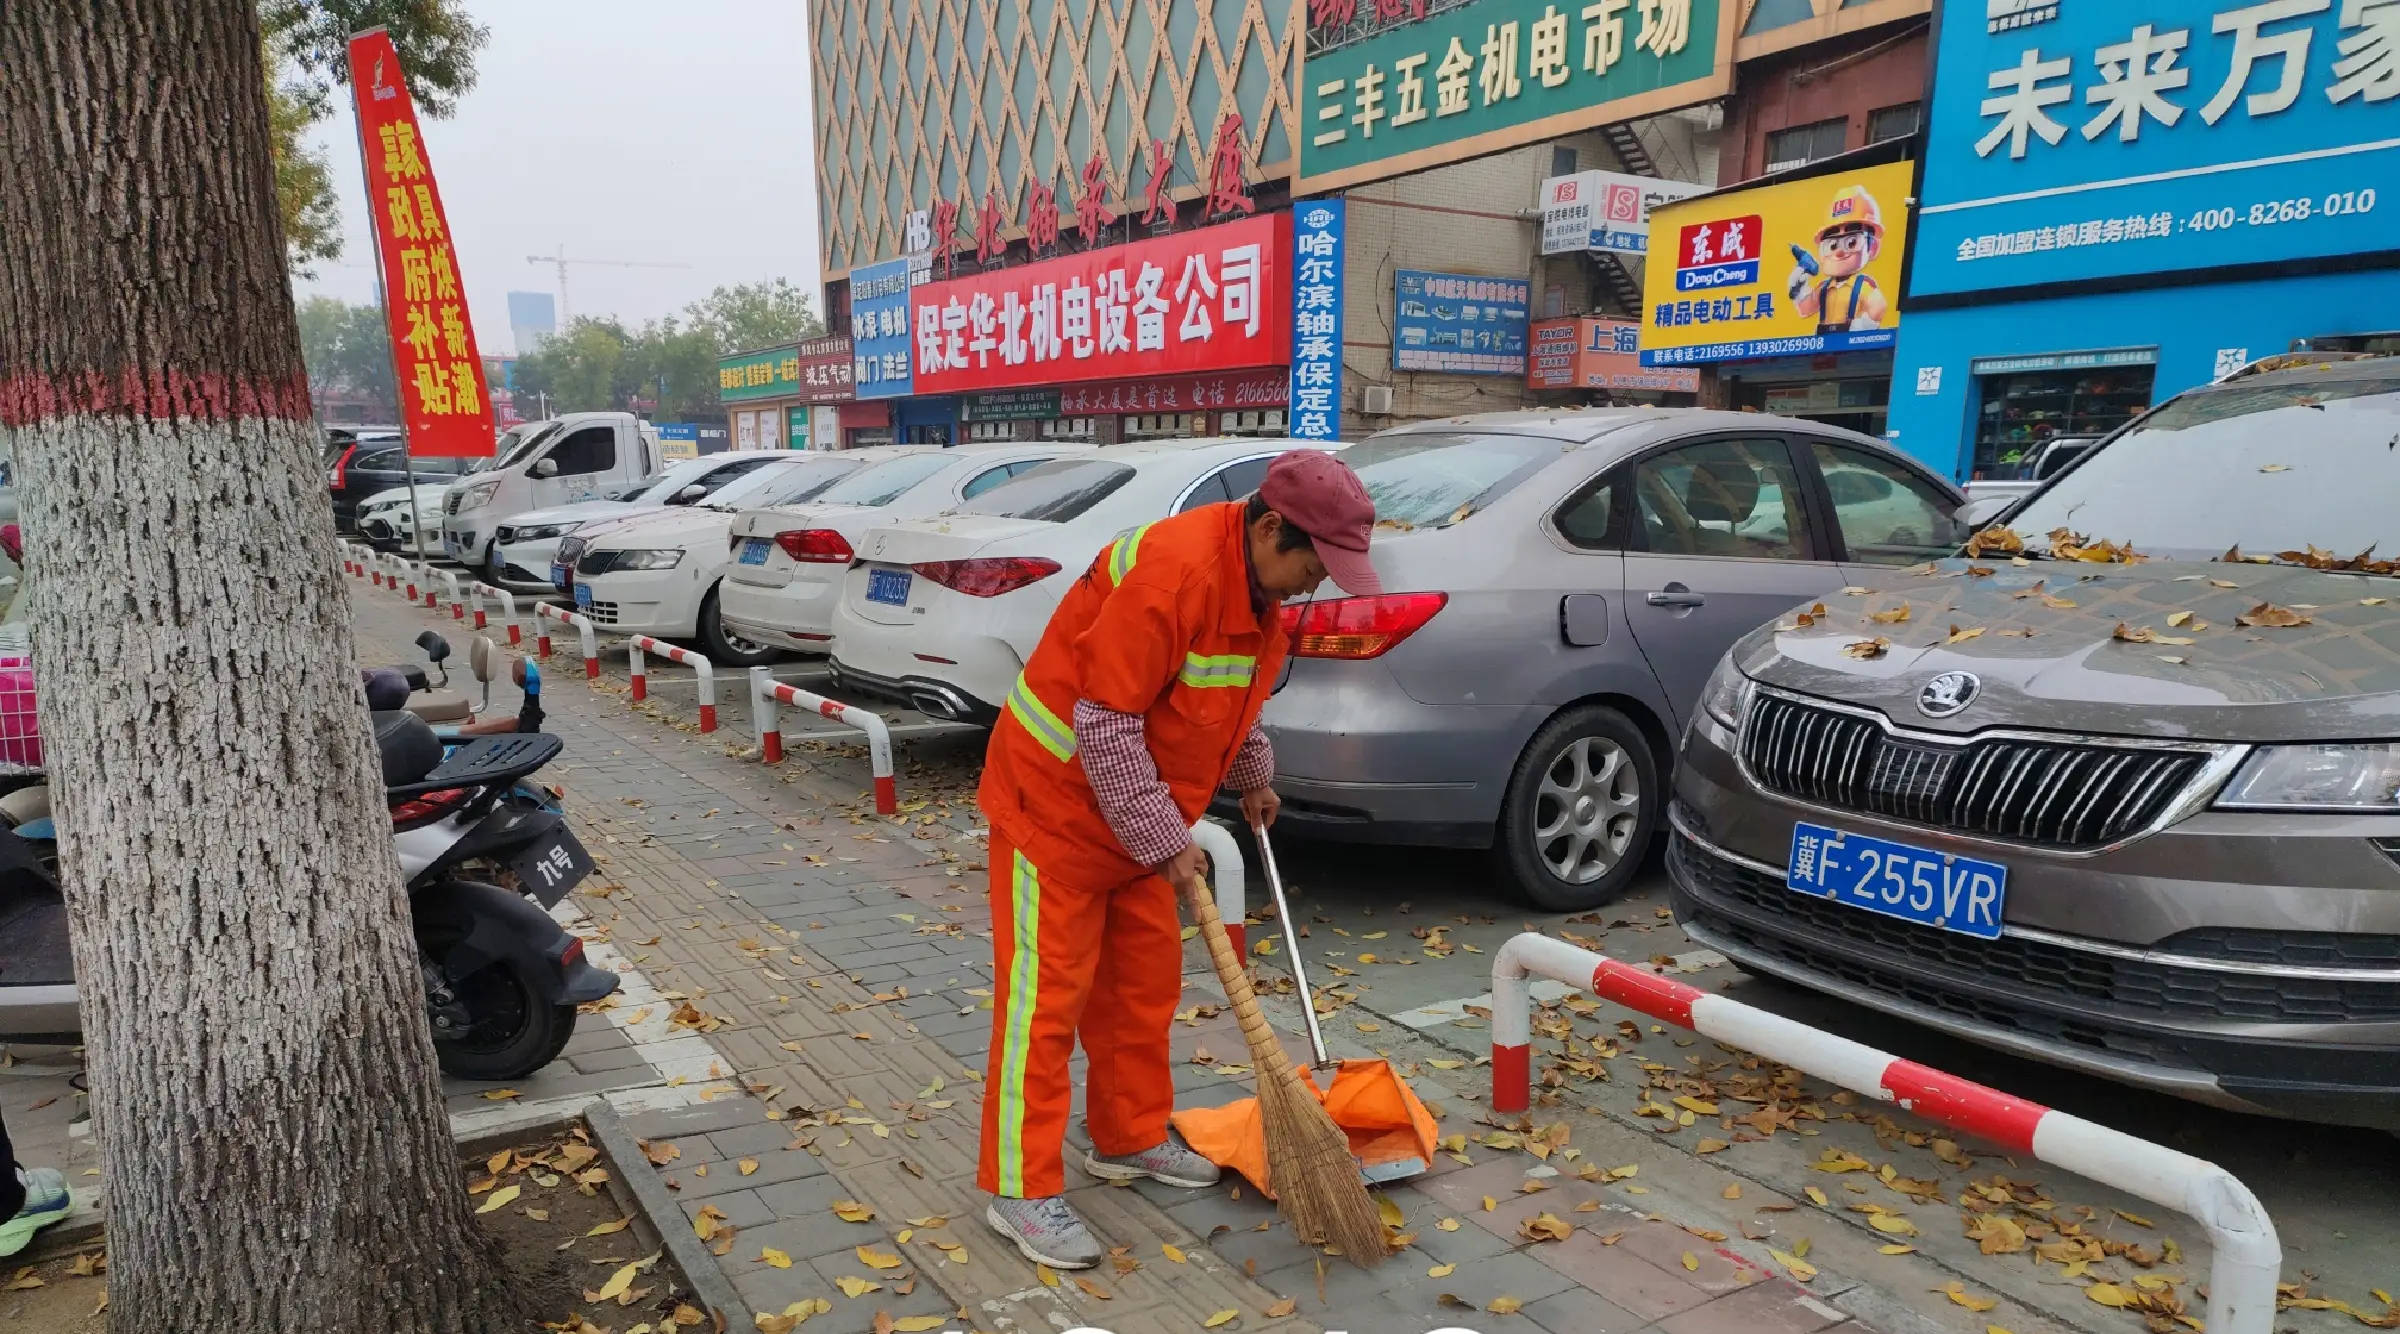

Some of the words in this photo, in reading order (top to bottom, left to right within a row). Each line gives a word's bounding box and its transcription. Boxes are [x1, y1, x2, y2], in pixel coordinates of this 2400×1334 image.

[1313, 0, 1691, 147] 三丰五金机电市场
[933, 113, 1256, 280] 华北轴承大厦
[906, 210, 932, 252] HB
[1691, 222, 1746, 264] 东成
[379, 122, 452, 416] 享政府补贴
[397, 119, 481, 416] 家具焕新潮
[880, 305, 907, 337] 电机
[916, 243, 1261, 375] 保定华北机电设备公司
[1654, 293, 1775, 328] 精品电动工具
[1294, 230, 1338, 440] 哈尔滨轴承保定总
[1586, 324, 1640, 354] 上海
[805, 361, 851, 386] 液压气动
[882, 351, 909, 381] 法兰
[1192, 379, 1226, 406] 电话
[537, 844, 574, 887] 九号
